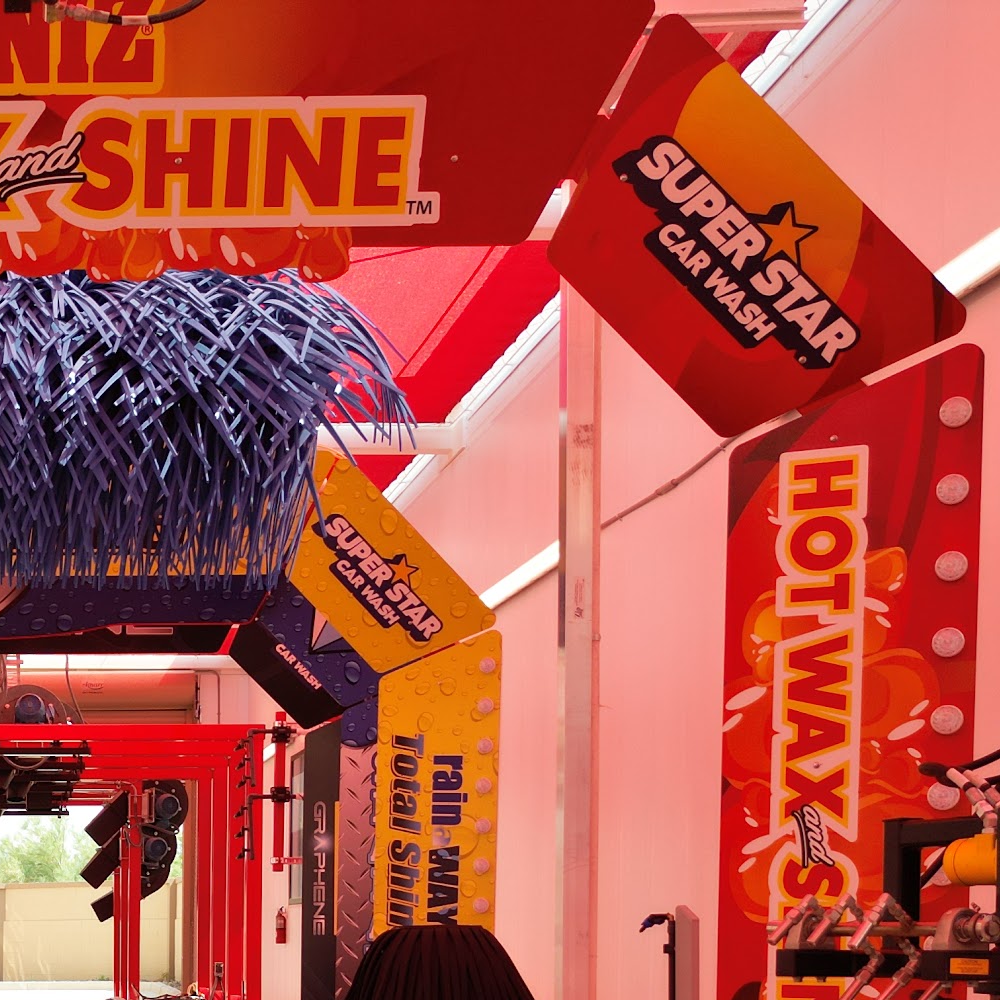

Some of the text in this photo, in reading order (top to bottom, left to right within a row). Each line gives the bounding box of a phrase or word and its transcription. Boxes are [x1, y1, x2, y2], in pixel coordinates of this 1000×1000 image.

[62, 107, 415, 219] SHINE
[636, 142, 857, 364] SUPER STAR
[658, 223, 778, 341] CAR WASH
[325, 517, 442, 640] SUPER STAR
[336, 559, 401, 625] CAR WASH
[784, 454, 858, 614] HOT
[275, 643, 323, 690] CAR WASH
[779, 627, 854, 830] WAX
[386, 733, 425, 927] Total Shin
[431, 755, 468, 826] rain
[791, 803, 835, 869] and
[312, 800, 326, 936] GRAPHENE
